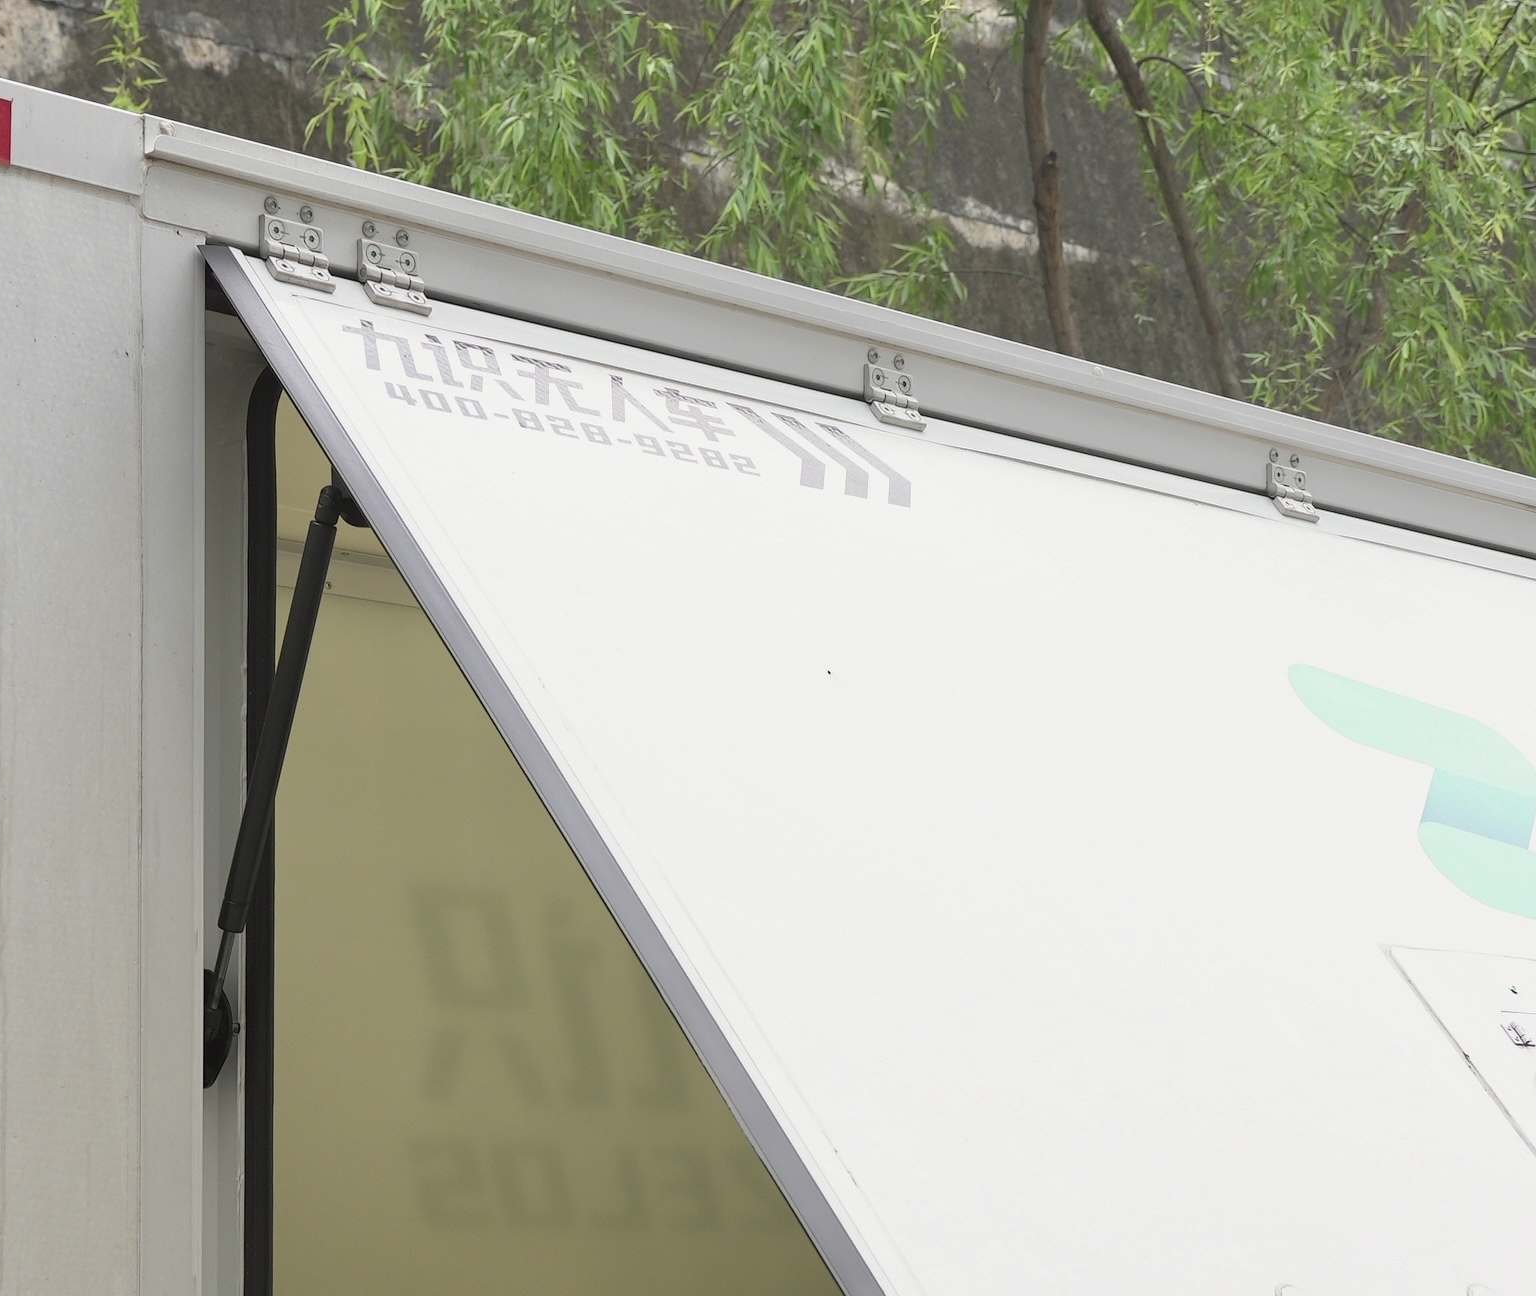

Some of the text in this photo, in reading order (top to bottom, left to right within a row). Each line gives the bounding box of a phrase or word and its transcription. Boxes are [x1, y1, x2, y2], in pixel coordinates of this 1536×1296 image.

[342, 319, 736, 444] 九识无人车
[385, 381, 761, 477] 400-828-9282
